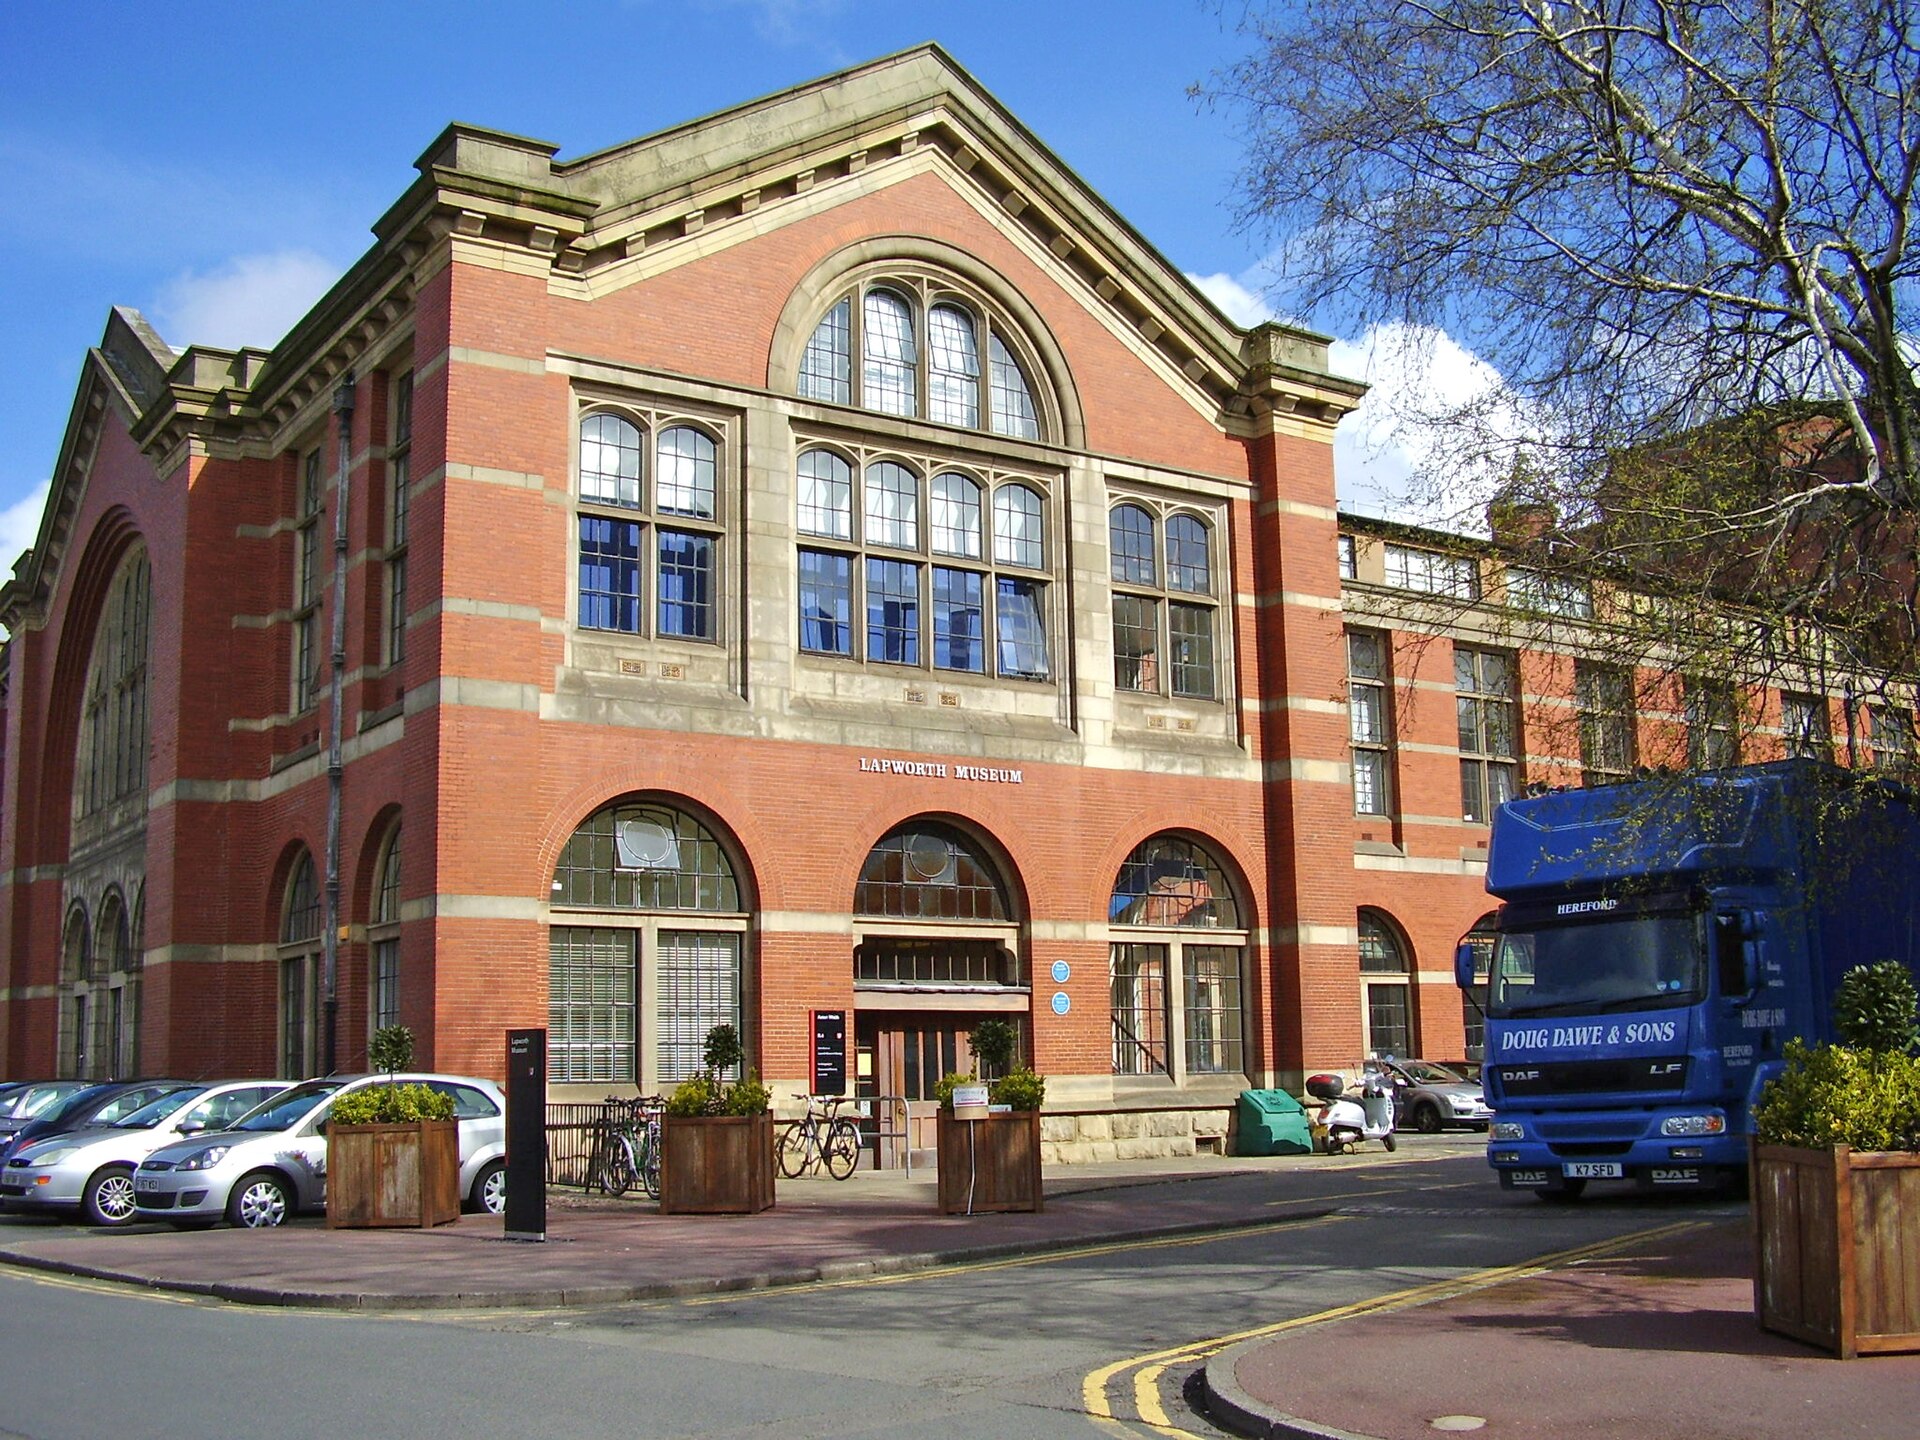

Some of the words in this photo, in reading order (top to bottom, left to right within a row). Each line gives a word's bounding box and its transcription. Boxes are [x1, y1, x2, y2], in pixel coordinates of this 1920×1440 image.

[859, 757, 947, 777] LAPWORTH
[954, 765, 1023, 783] MUSEUM
[1557, 899, 1617, 914] HEREFORD
[1502, 1029, 1548, 1050] DOUG
[1552, 1026, 1603, 1047] DAWE
[1607, 1025, 1620, 1044] &
[1625, 1021, 1676, 1043] SONS
[1650, 1063, 1682, 1074] LF
[1502, 1071, 1540, 1081] DAF
[1575, 1164, 1589, 1176] K7
[1592, 1163, 1615, 1176] SFD
[1652, 1169, 1699, 1179] DAF
[1511, 1171, 1548, 1181] DAF
